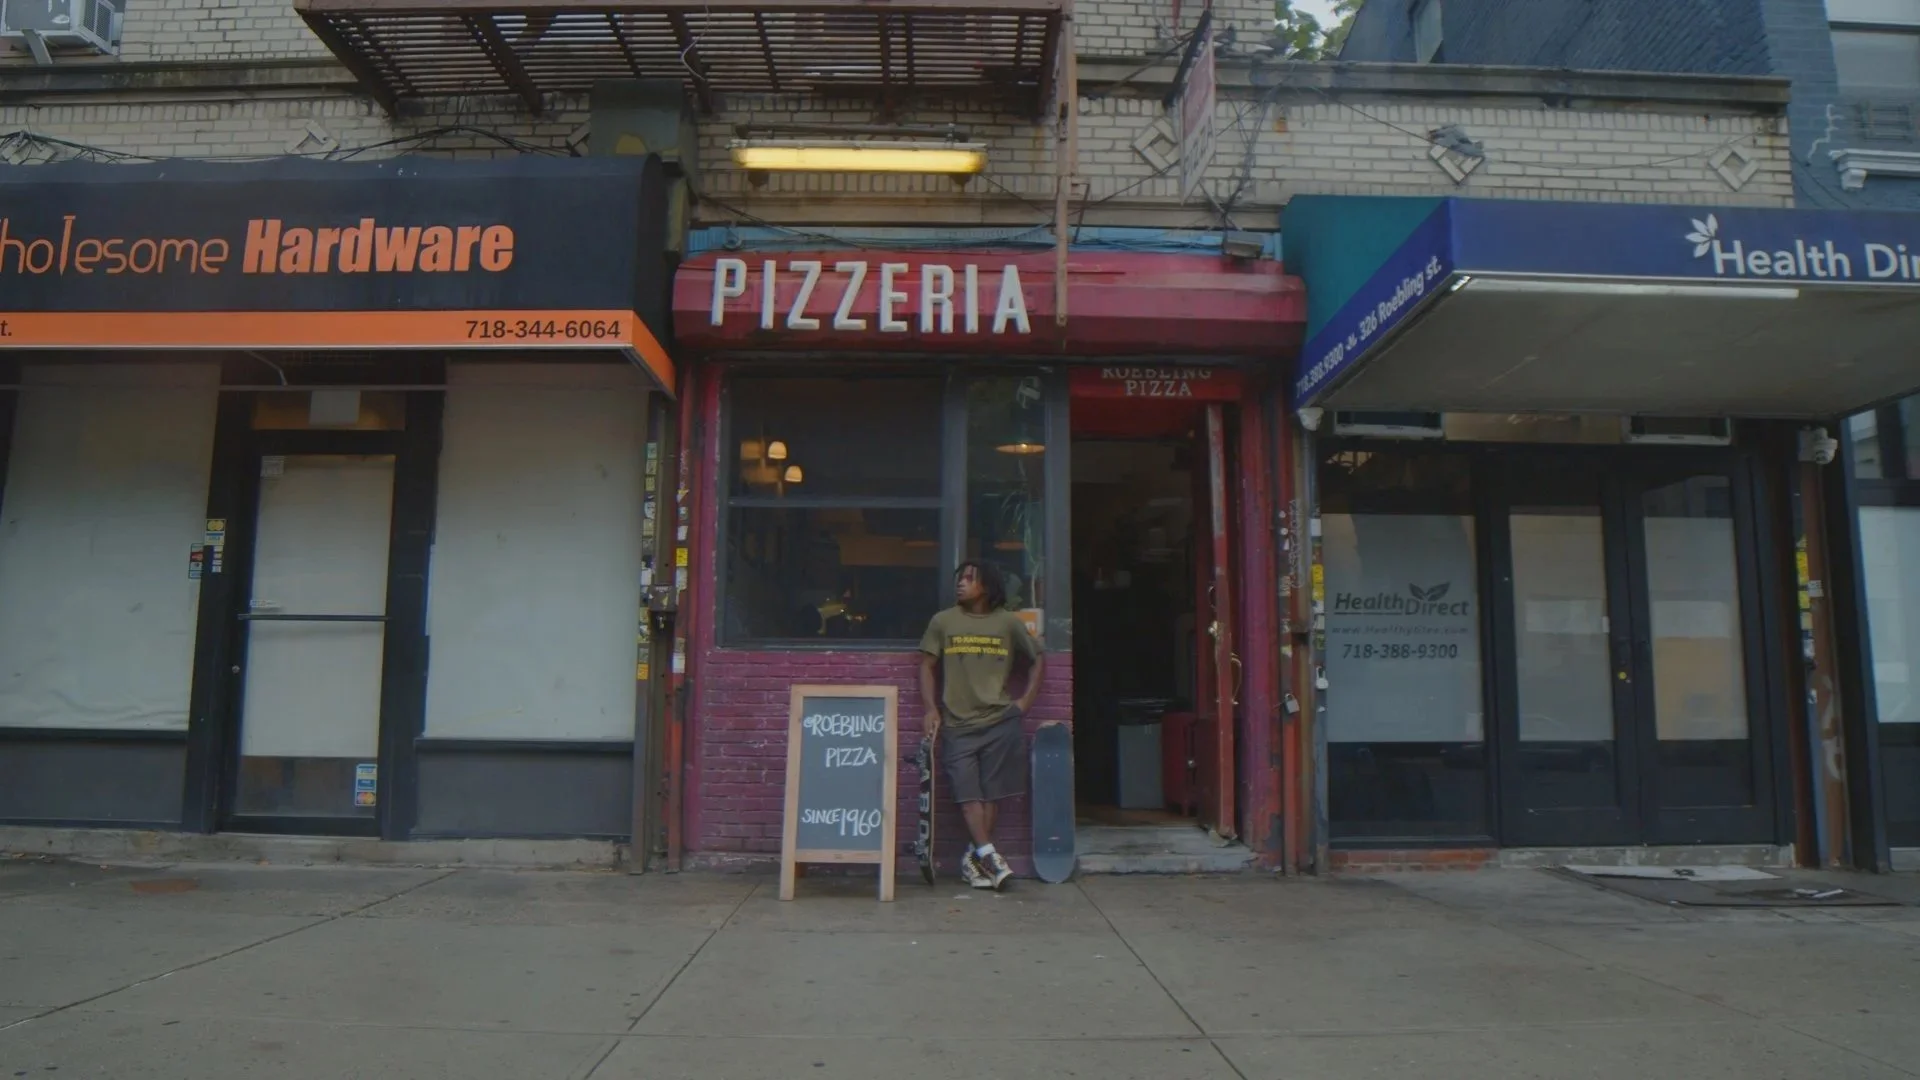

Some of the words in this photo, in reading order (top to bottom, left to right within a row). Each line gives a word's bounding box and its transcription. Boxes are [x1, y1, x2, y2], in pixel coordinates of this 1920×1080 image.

[0, 215, 230, 275] holesome
[241, 217, 515, 274] Hardware
[1711, 239, 1852, 277] Health
[710, 258, 1031, 334] PIZZERIA
[1359, 310, 1378, 341] 326
[1378, 272, 1425, 324] Roebling
[1425, 255, 1442, 280] st.
[465, 320, 622, 339] 718-344-6064
[1125, 380, 1193, 397] PIZZA
[1343, 643, 1459, 659] 718-388-9300
[825, 747, 878, 768] PIZZA
